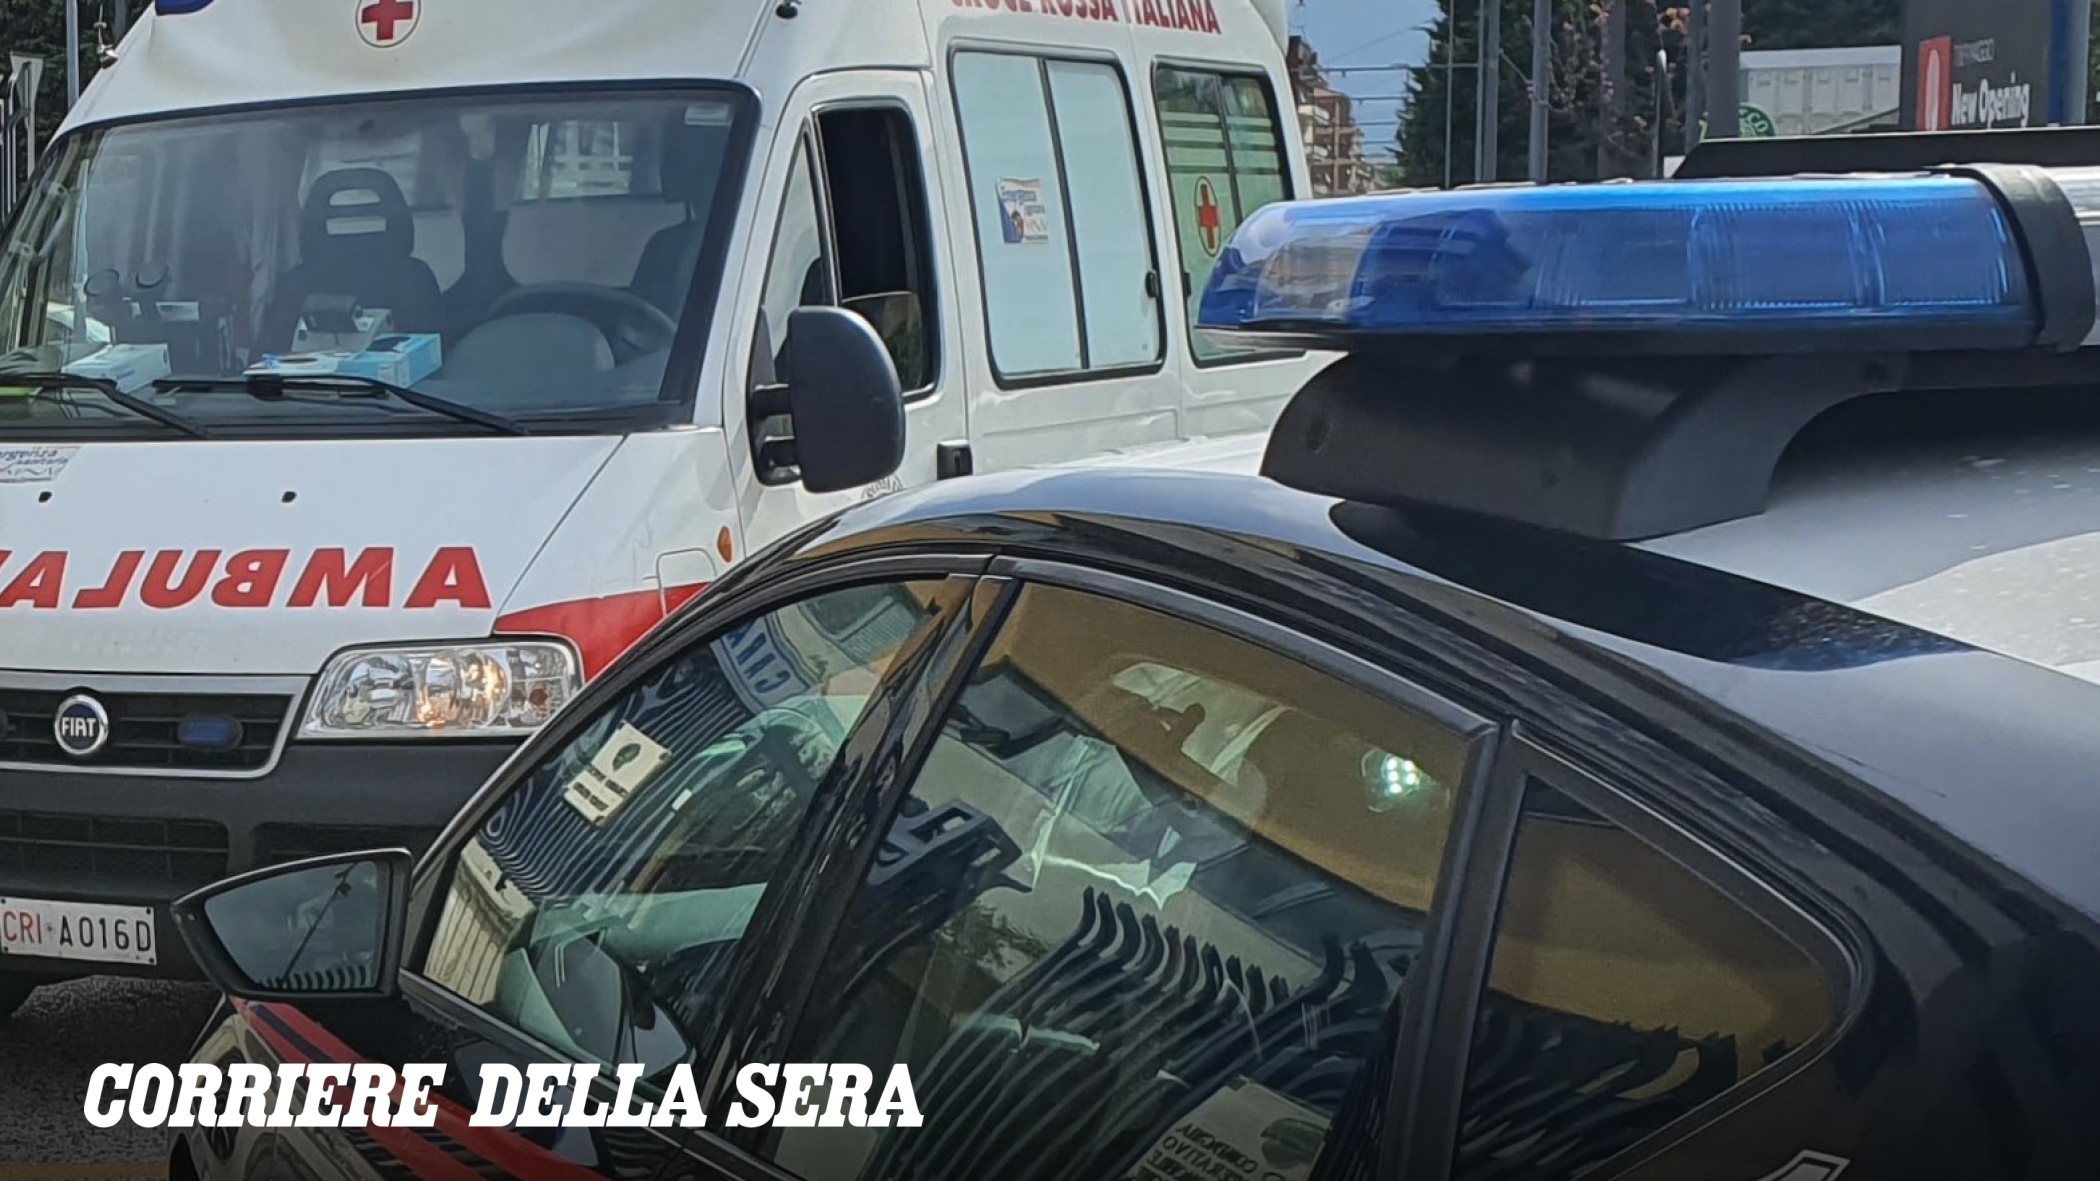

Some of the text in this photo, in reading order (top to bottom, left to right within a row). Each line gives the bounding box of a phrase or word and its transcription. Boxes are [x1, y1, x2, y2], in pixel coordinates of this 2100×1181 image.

[1979, 71, 2030, 128] Opening
[62, 716, 97, 737] FIAT
[3, 911, 42, 944] CRI
